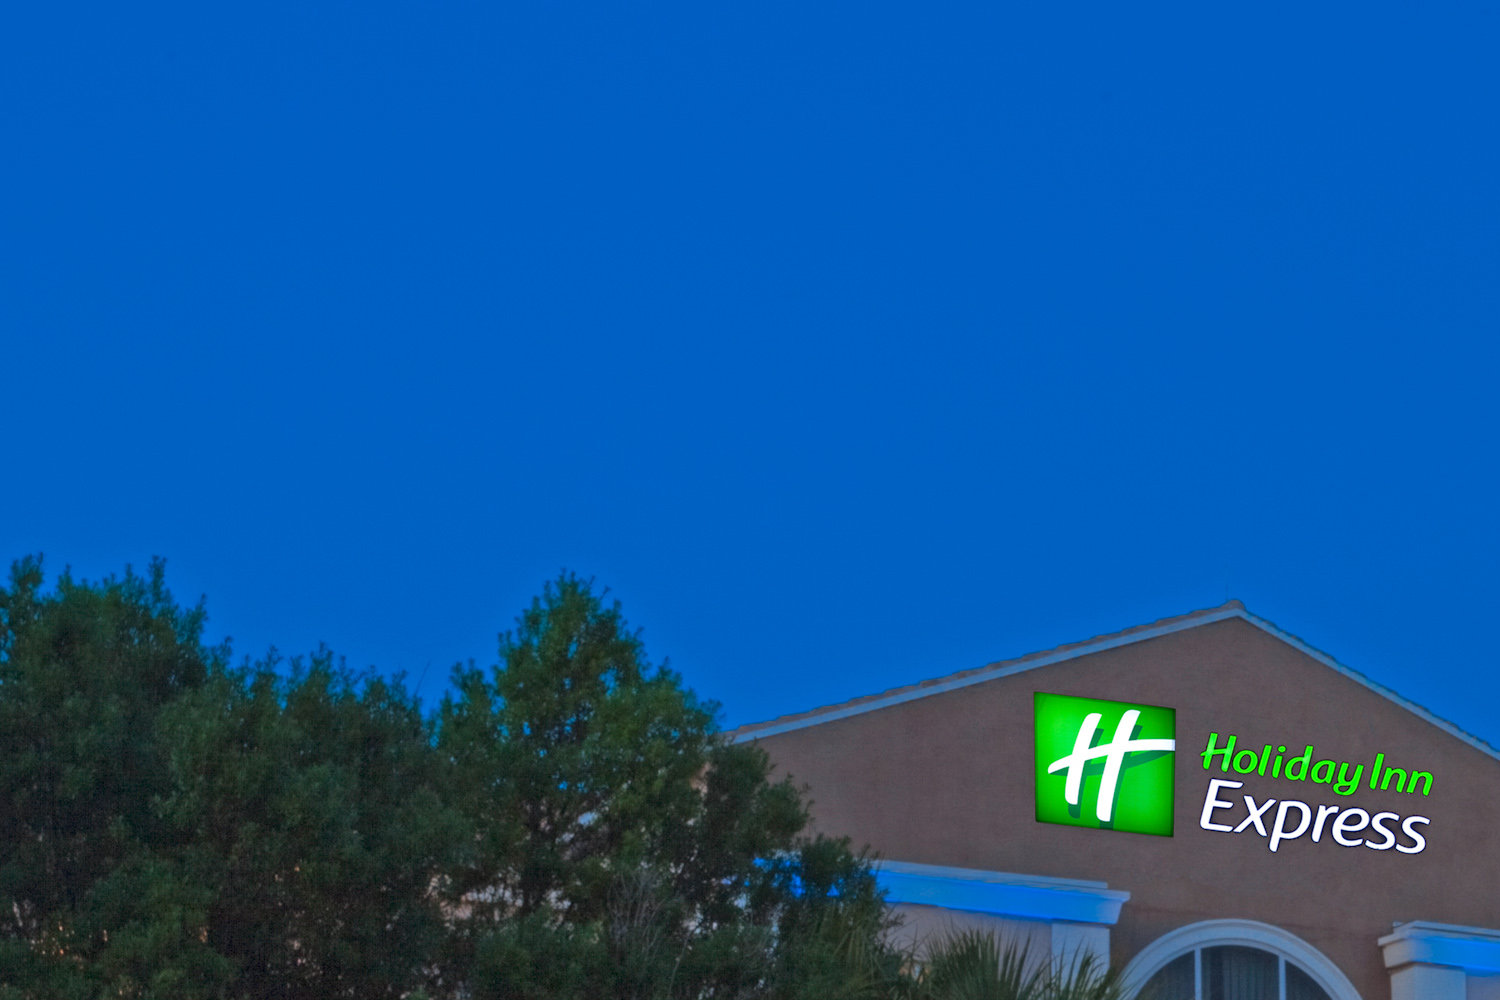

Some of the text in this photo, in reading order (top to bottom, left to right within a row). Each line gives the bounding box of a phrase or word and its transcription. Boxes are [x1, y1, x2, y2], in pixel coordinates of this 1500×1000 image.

[1047, 709, 1176, 823] H
[1200, 732, 1434, 797] Holiday Inn
[1199, 778, 1431, 854] Express
